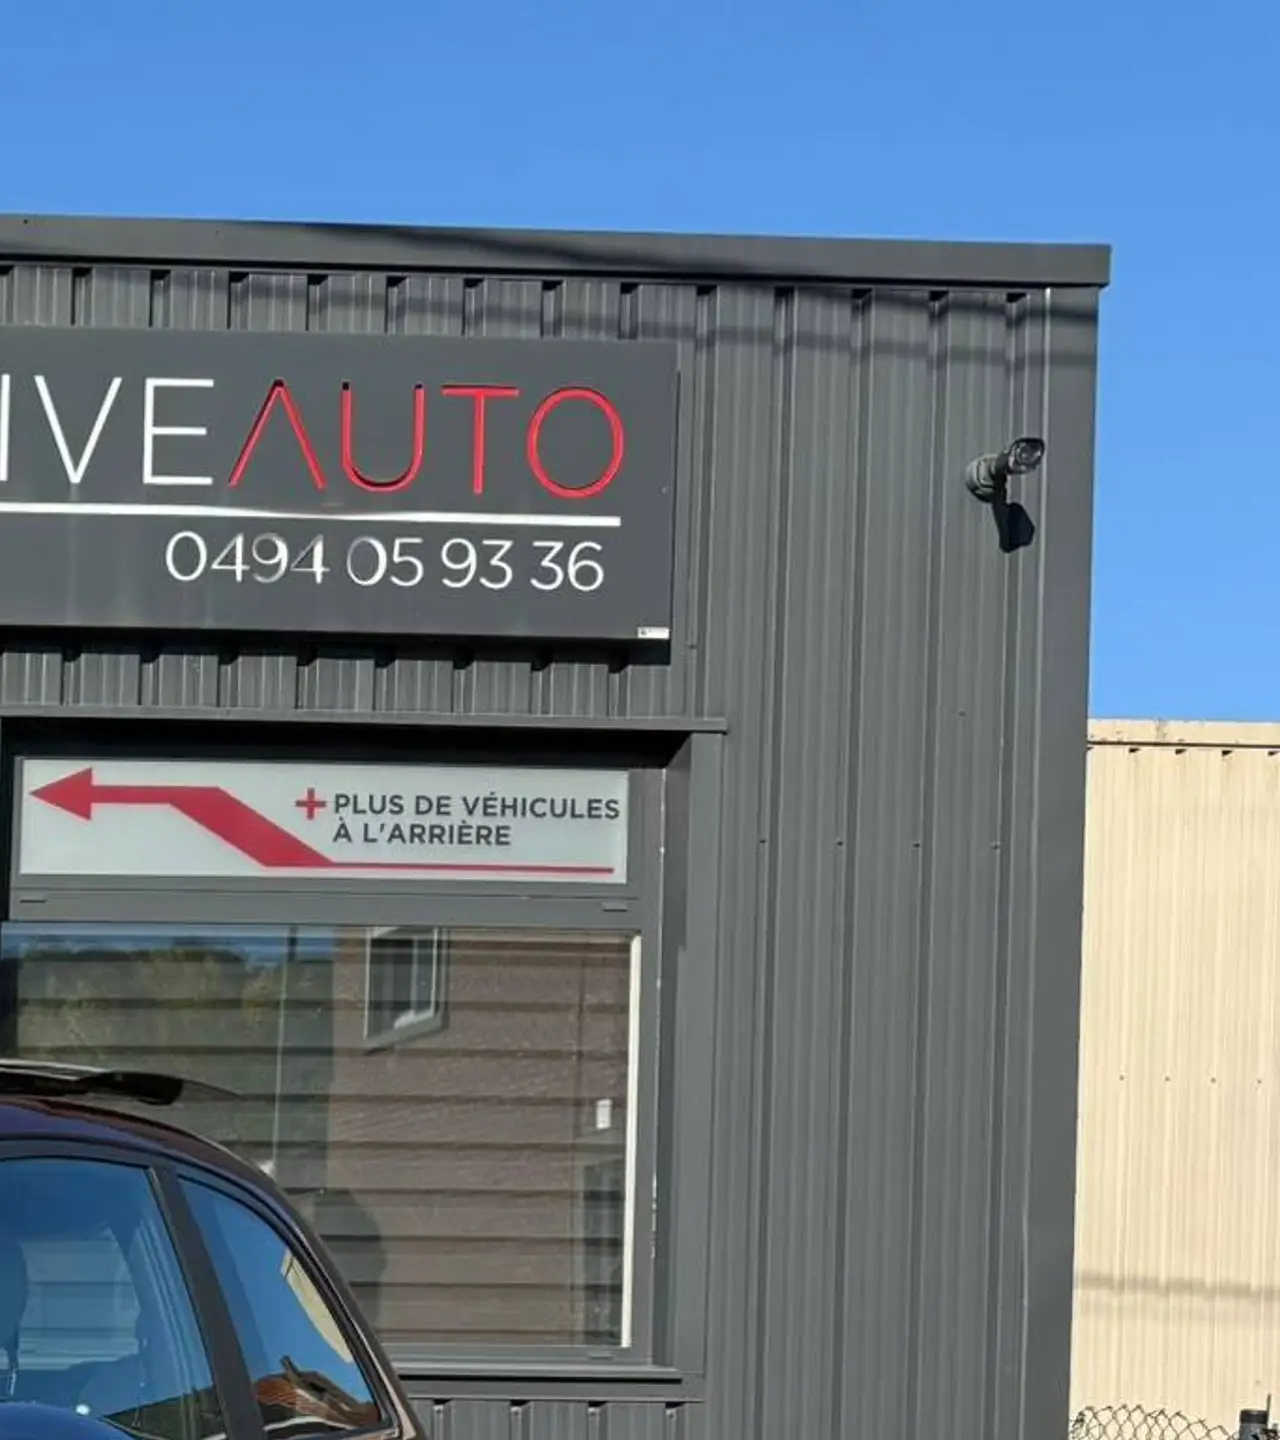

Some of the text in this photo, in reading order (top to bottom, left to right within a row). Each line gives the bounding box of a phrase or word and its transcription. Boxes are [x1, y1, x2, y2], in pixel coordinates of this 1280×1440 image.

[165, 530, 606, 592] 0494 05 93 36
[333, 789, 621, 820] PLUS DE VÉHICULES
[332, 815, 512, 847] À L'ARRIÈRE
